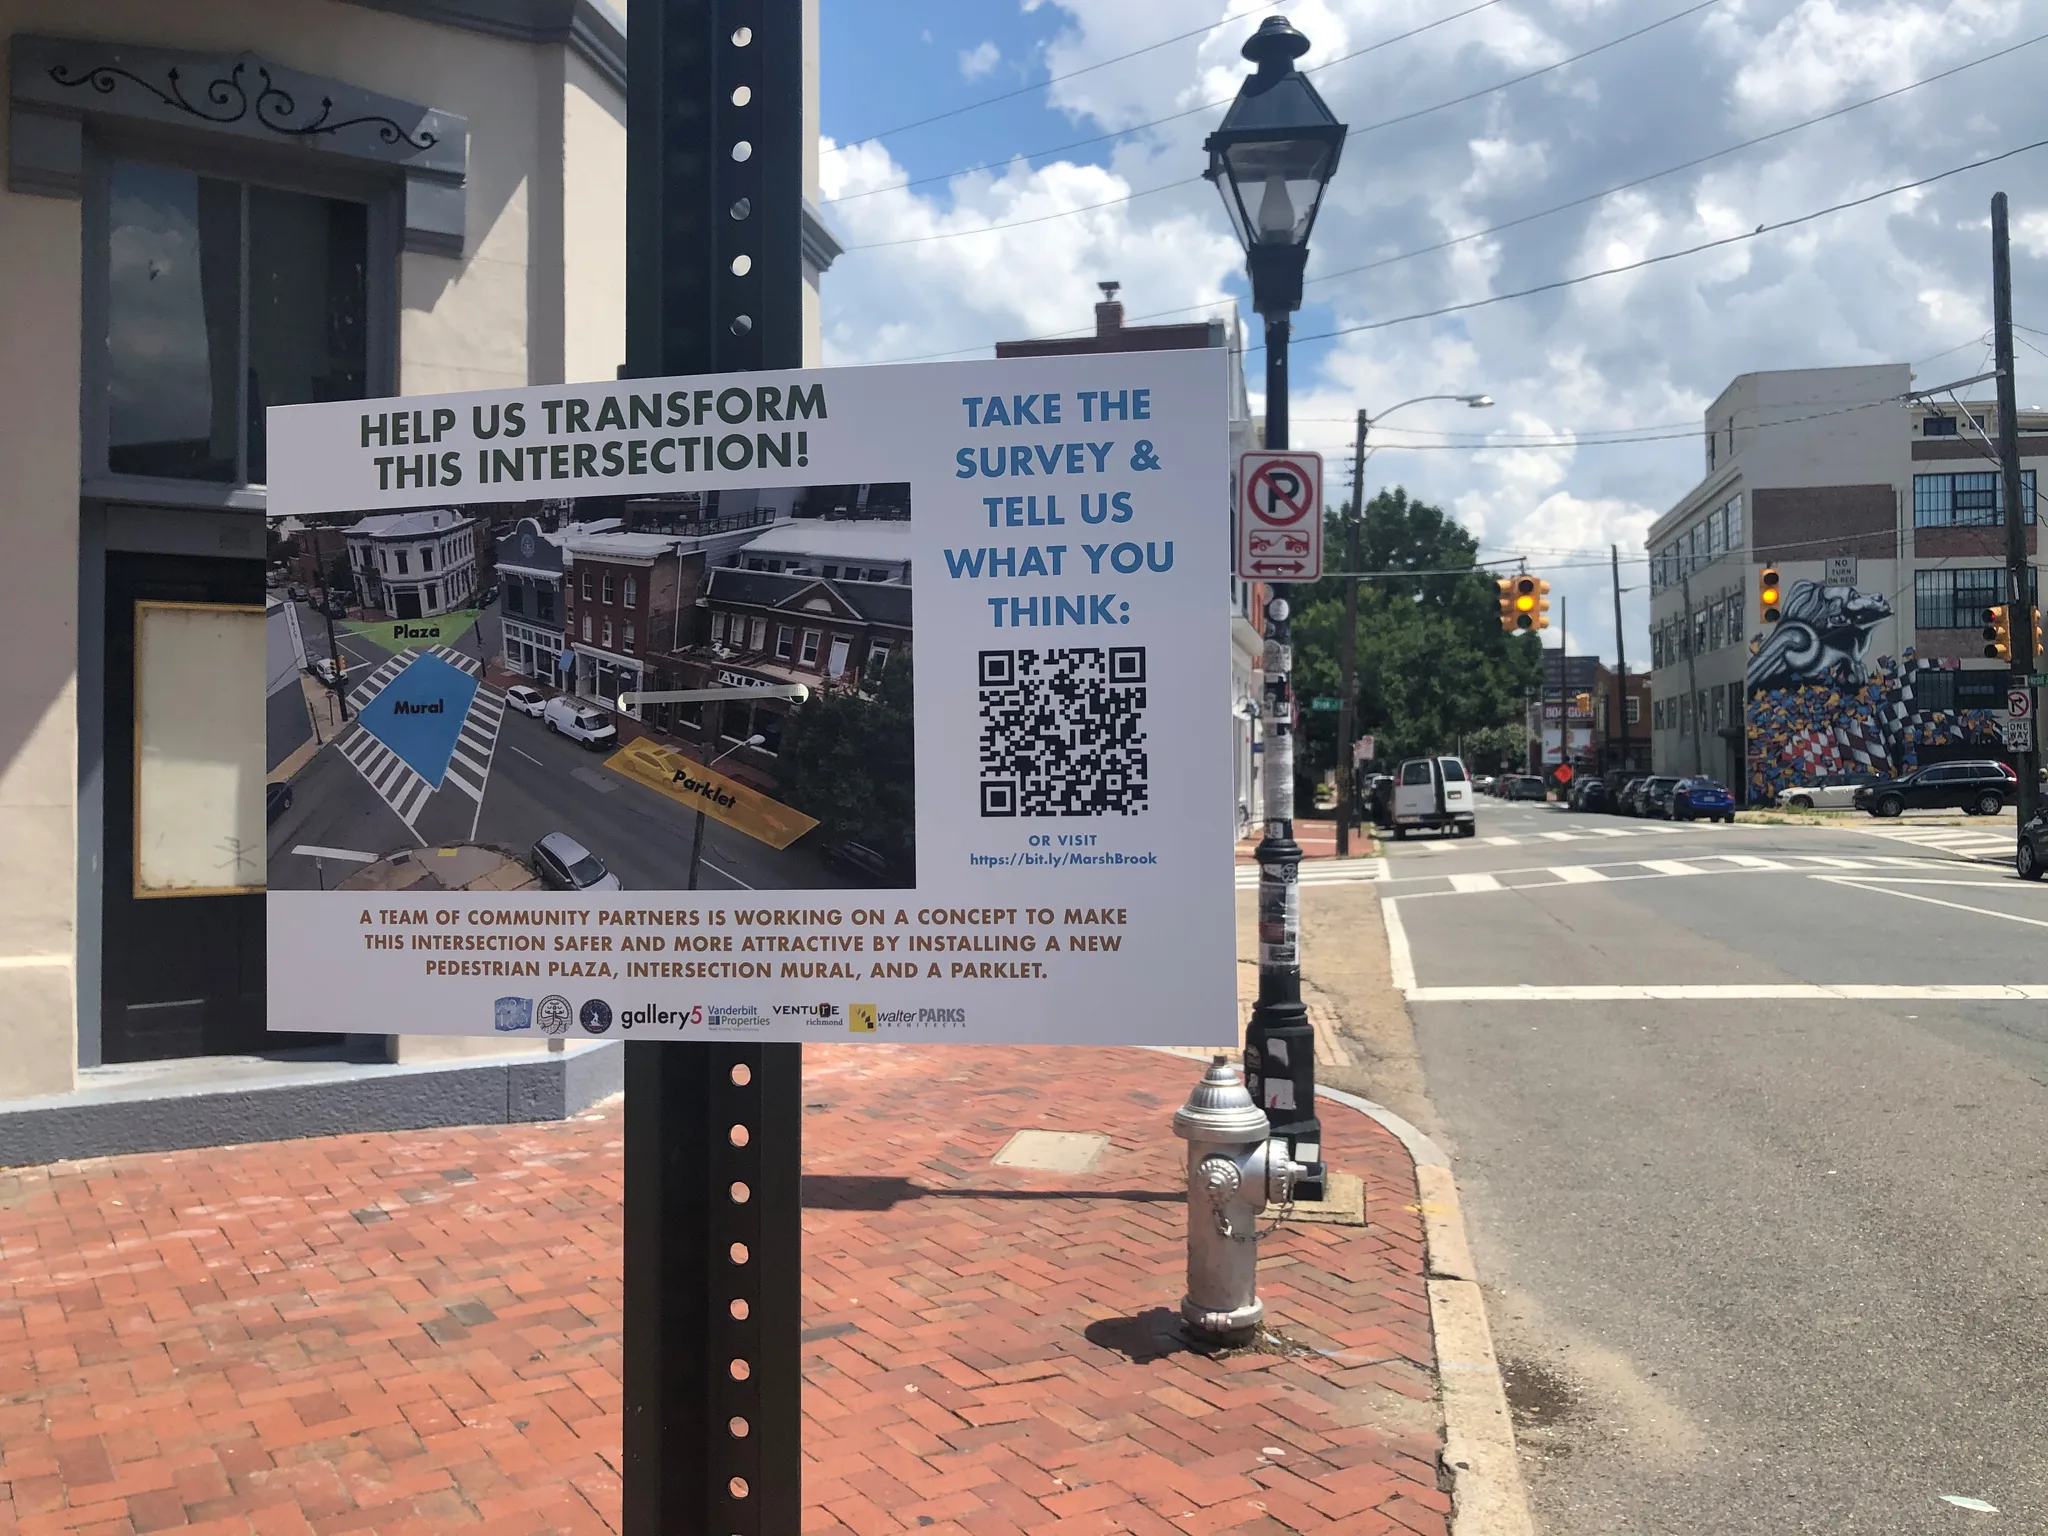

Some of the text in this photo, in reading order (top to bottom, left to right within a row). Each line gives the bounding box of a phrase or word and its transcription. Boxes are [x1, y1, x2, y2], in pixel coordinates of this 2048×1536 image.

[361, 383, 828, 447] HELP US TRANSFORM
[963, 389, 1151, 427] TAKE THE
[374, 431, 809, 490] THIS INTERSECTION!
[956, 440, 1162, 478] SURVEY &
[983, 491, 1134, 527] TELL US
[944, 541, 1174, 578] WHAT YOU
[1835, 559, 1848, 567] NO
[1832, 568, 1851, 576] TURN
[988, 594, 1130, 627] THINK:
[394, 624, 440, 639] Plaza
[394, 699, 444, 714] Mural
[2010, 722, 2029, 731] ONE
[2010, 731, 2029, 740] WAY
[672, 769, 737, 809] Parklet
[1029, 835, 1098, 847] OR VISIT
[970, 851, 1158, 869] https://bit.ly/MarshBrook
[360, 909, 1126, 925] A TEAM OF COMMUNITY PARTNERS IS WORKING ON A CONCEPT TO MAKE
[365, 935, 1122, 952] THIS INTERSECTION SAFER AND MORE ATTRACTIVE BY INSTALLING A NEW
[427, 961, 1048, 980] PEDESTRIAN PLAZA, INTERSECTION MURAL, AND A PARKLET.
[621, 1003, 702, 1030] gallery5
[708, 1005, 757, 1015] Vanderbilt
[877, 1008, 966, 1022] walter PARKS
[721, 1015, 770, 1027] Properties
[806, 1018, 843, 1026] richmond
